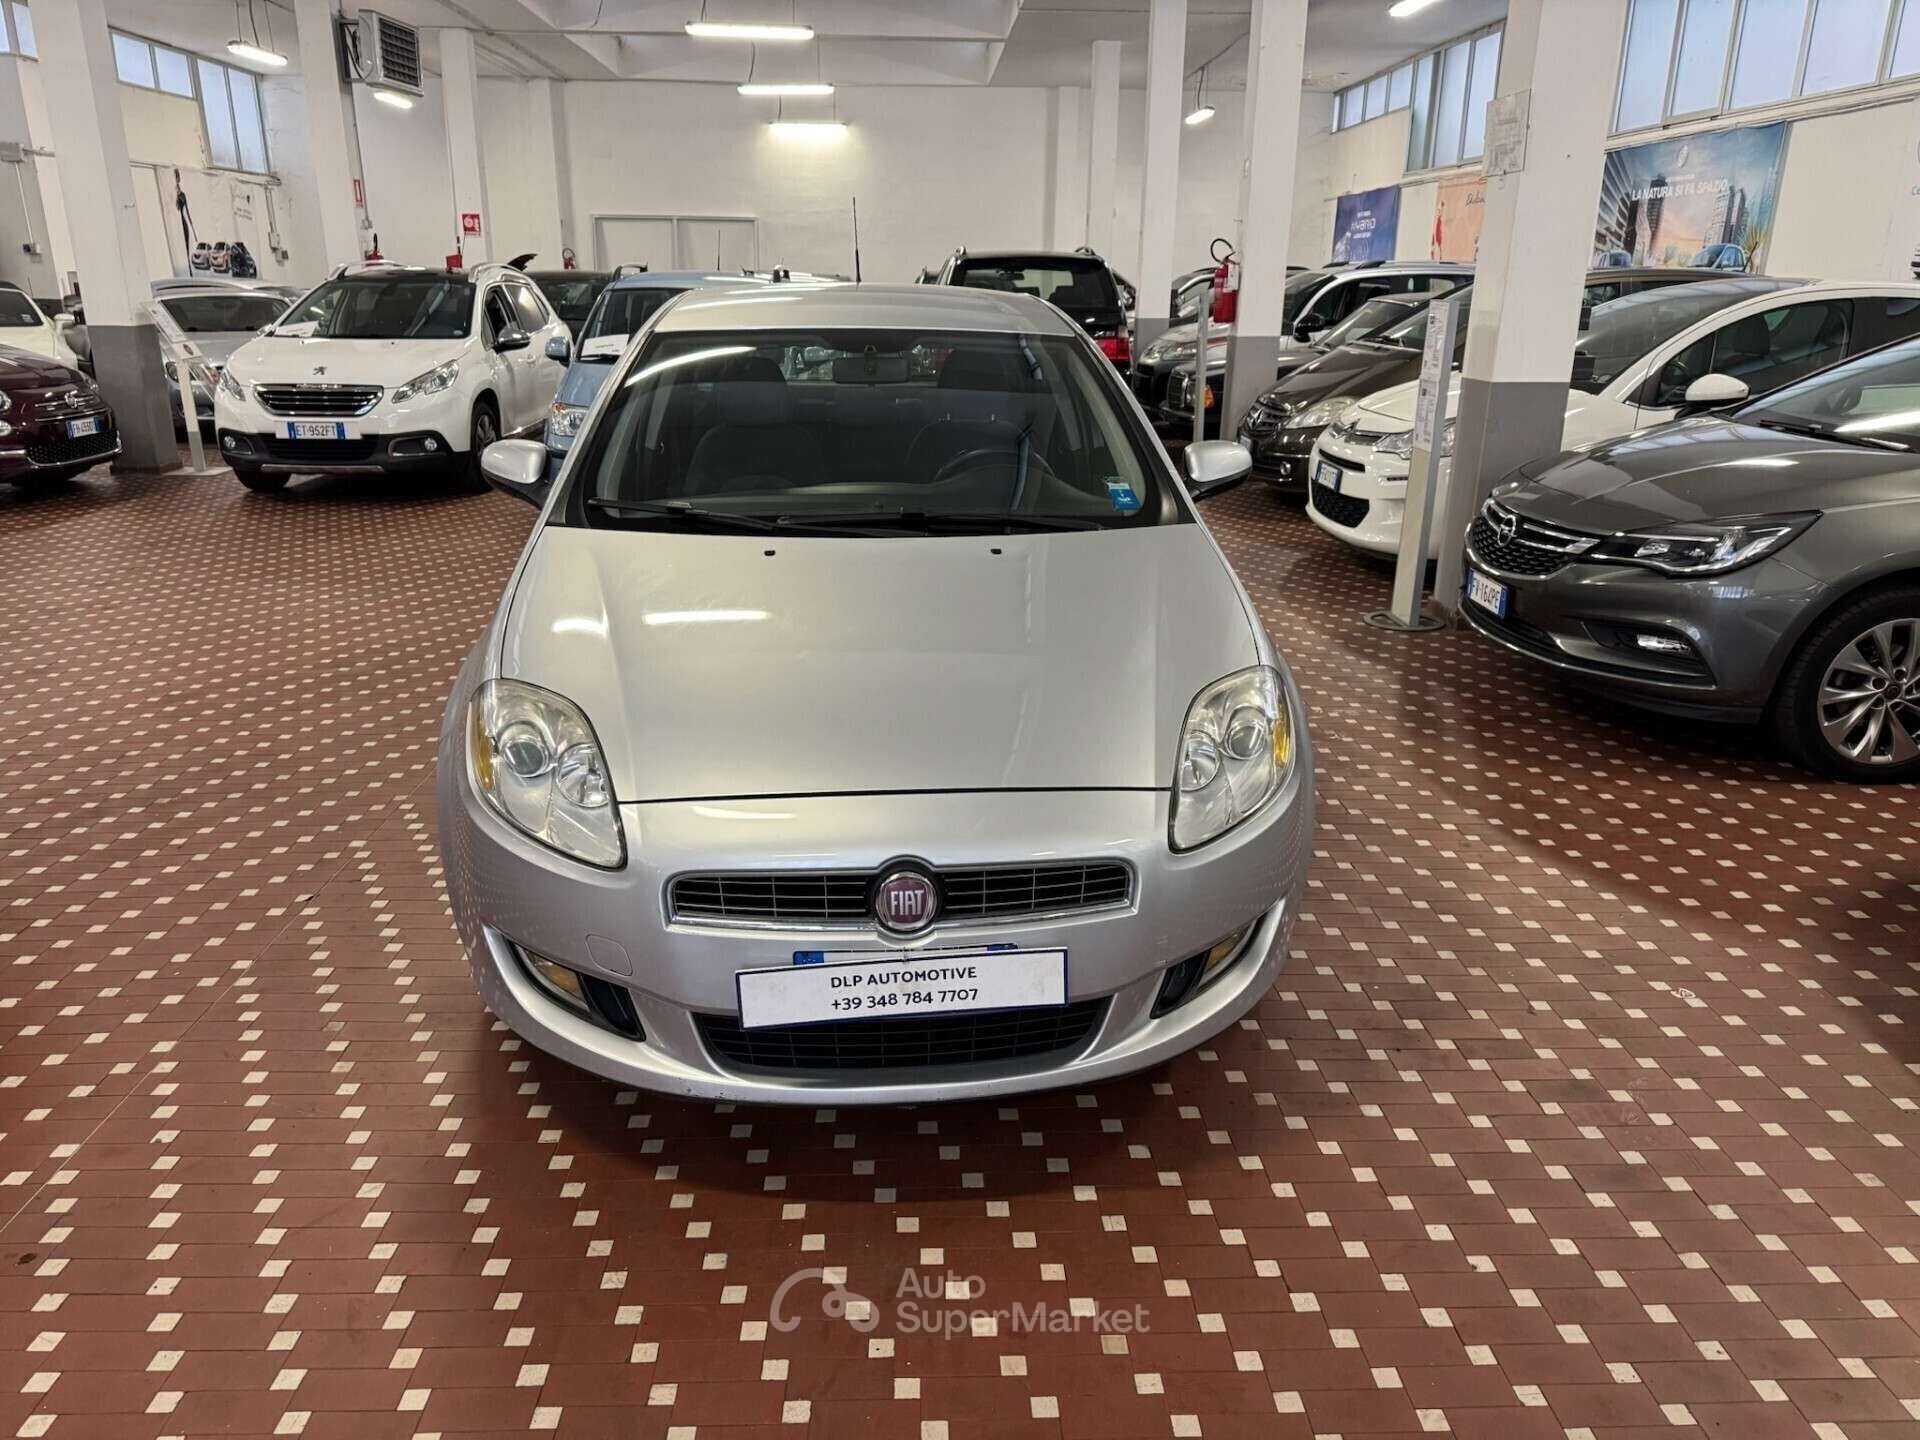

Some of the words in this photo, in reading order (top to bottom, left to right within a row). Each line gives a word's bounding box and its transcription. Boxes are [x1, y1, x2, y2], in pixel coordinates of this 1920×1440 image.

[1632, 189, 1641, 201] LA
[1642, 186, 1673, 200] NATURA
[1675, 184, 1684, 197] SI
[1684, 183, 1694, 196] FA
[1697, 178, 1729, 194] SPAZIO
[890, 889, 924, 915] FIAT
[830, 974, 863, 989] DLP
[867, 966, 977, 987] AUTOMOTIVE
[831, 996, 862, 1011] +39
[867, 993, 898, 1009] 348
[902, 991, 934, 1006] 784
[938, 988, 979, 1004] 7707
